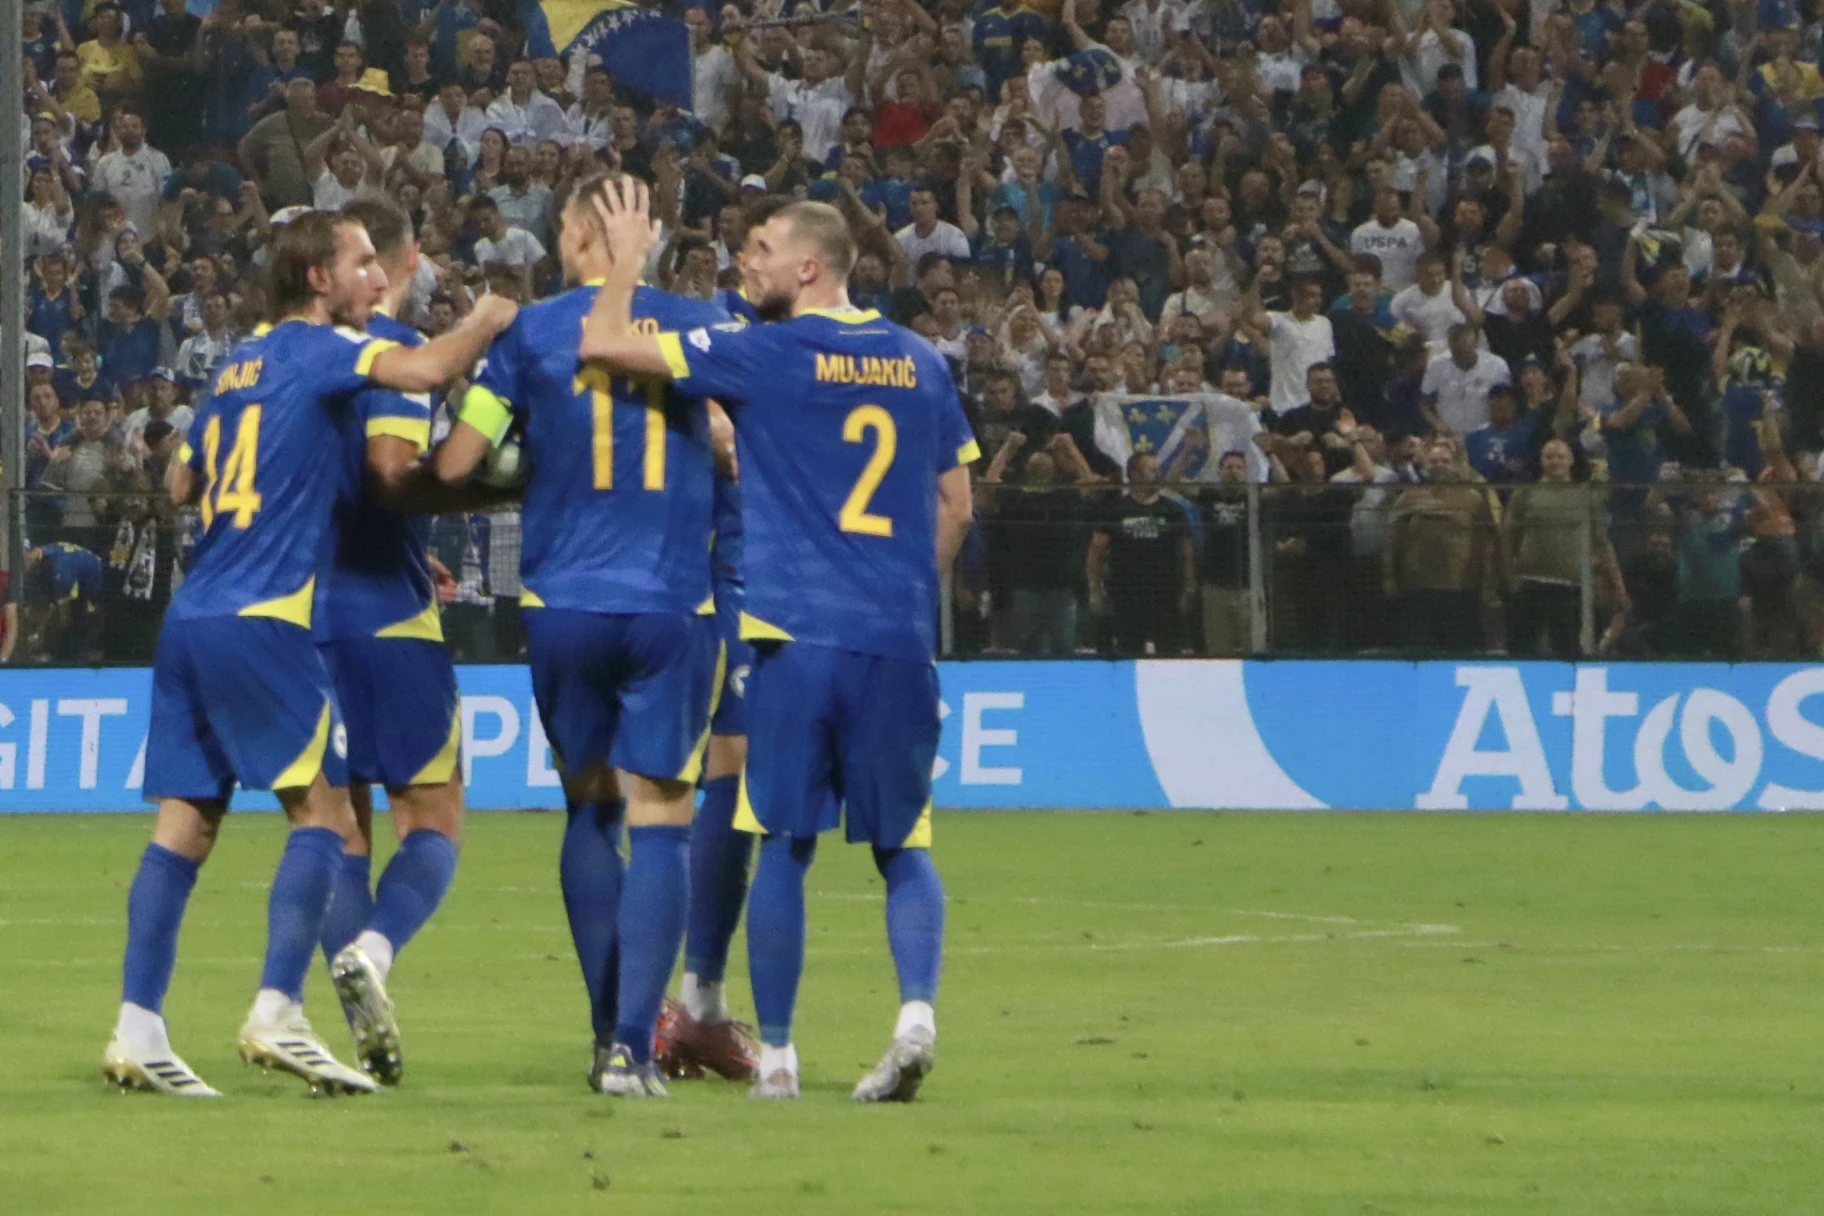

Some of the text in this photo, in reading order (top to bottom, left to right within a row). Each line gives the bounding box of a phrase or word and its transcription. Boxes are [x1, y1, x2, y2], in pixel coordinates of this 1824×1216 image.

[815, 354, 917, 389] MUJAKIĆ
[201, 403, 262, 535] 14
[838, 404, 898, 538] 2
